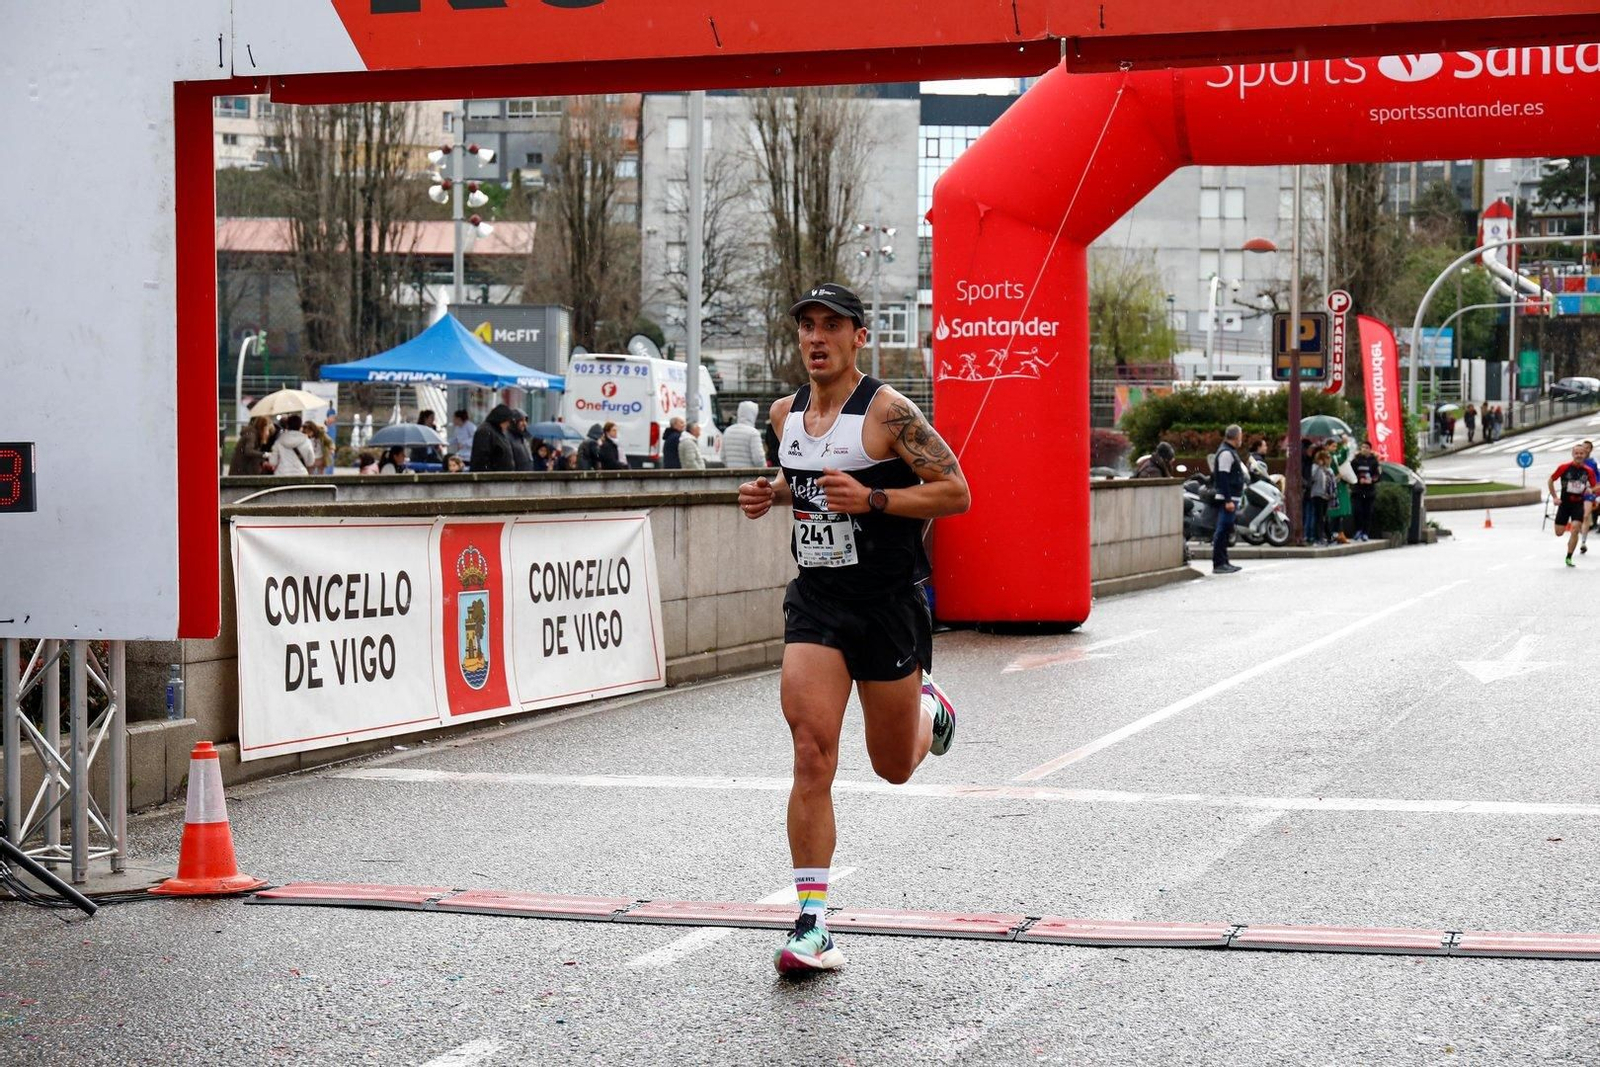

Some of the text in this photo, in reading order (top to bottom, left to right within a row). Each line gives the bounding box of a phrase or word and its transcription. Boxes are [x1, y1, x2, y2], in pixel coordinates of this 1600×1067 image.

[1369, 100, 1544, 125] sportssantander.es
[956, 280, 1024, 306] Sports
[1331, 294, 1347, 311] P
[494, 329, 540, 342] McFIT
[951, 316, 1059, 338] Santander
[1285, 319, 1315, 352] P
[1334, 316, 1343, 381] PARKING
[574, 363, 648, 377] 902 55 78 98
[575, 398, 643, 415] OneFurgO
[800, 523, 834, 546] 241
[529, 556, 631, 604] CONCELLO
[264, 569, 412, 627] CONCELLO
[542, 609, 622, 658] DE VIGO
[285, 633, 396, 692] DE VIGO
